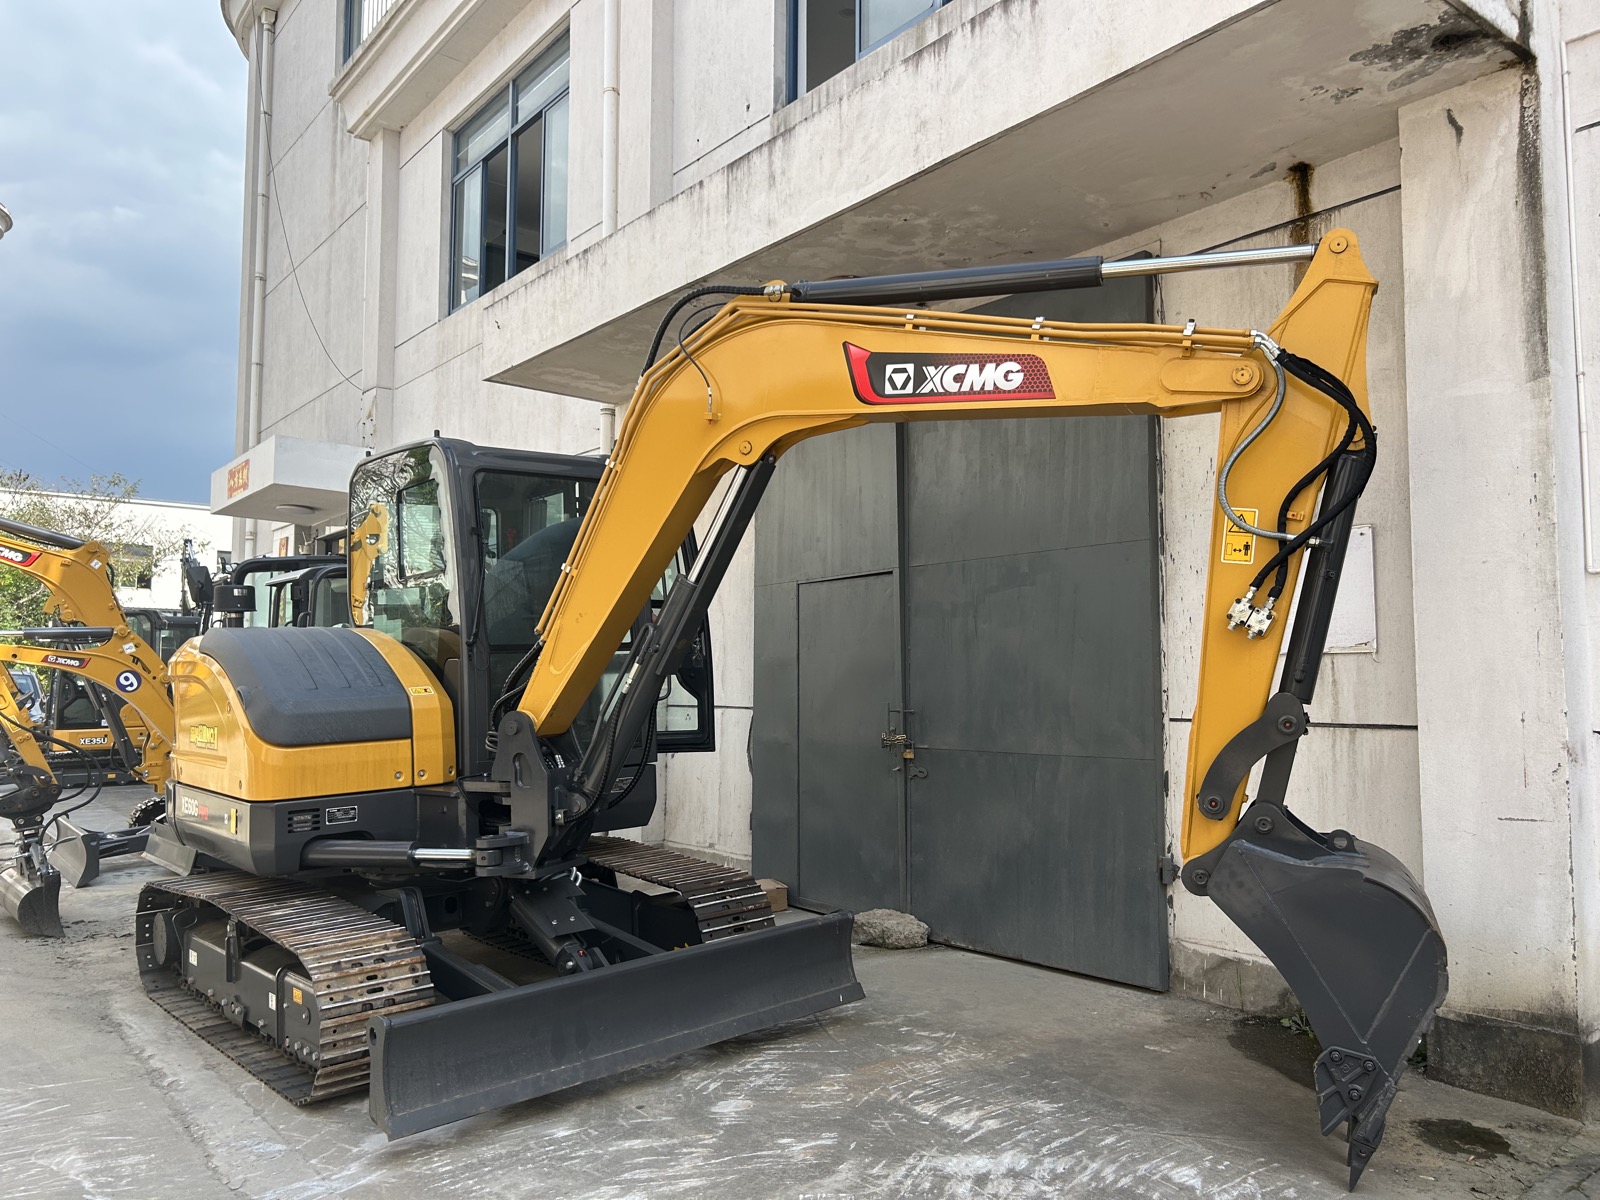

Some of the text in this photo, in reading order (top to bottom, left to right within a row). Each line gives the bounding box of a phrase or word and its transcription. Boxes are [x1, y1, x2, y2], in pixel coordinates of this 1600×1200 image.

[915, 361, 1024, 394] XCMG
[56, 656, 80, 667] XCMG
[119, 672, 138, 692] 9
[80, 737, 107, 745] XE35U
